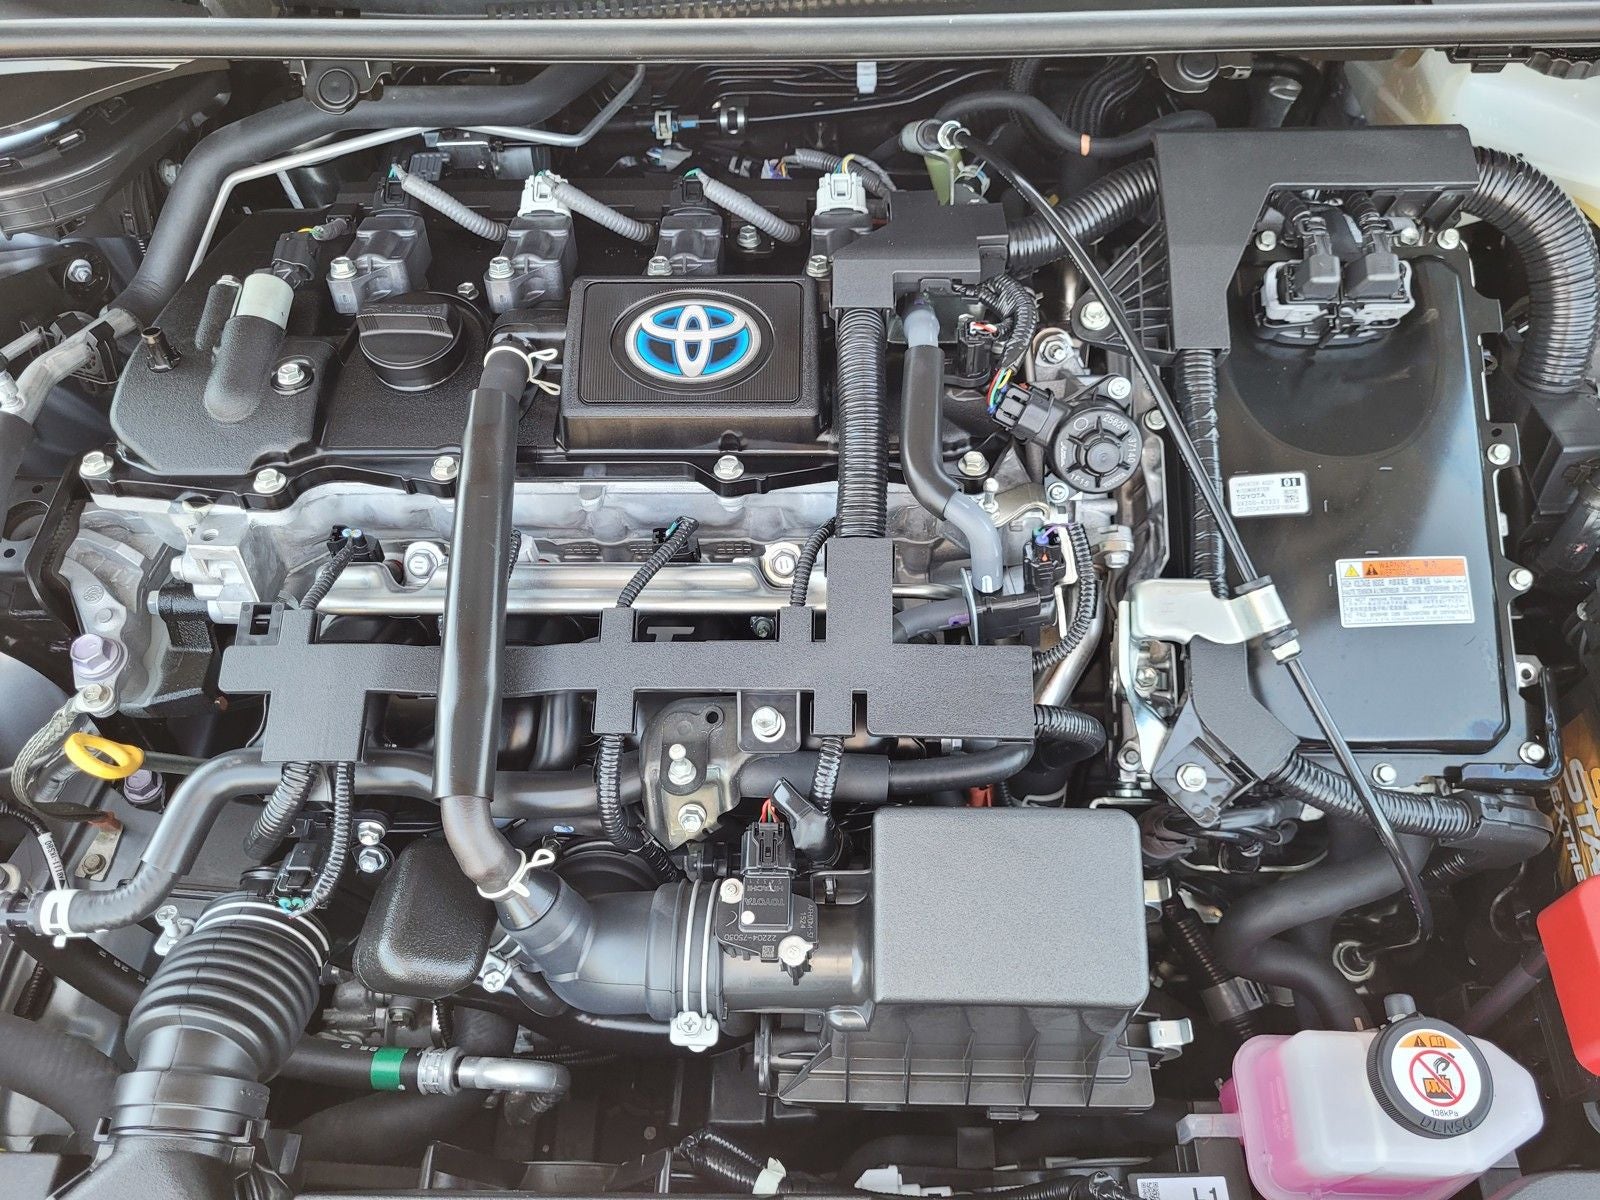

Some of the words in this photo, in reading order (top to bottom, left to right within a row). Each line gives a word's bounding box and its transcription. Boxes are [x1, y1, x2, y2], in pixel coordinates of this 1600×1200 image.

[1103, 413, 1128, 431] 25620
[1128, 438, 1137, 463] 37140
[745, 897, 785, 906] TOYOTA
[1431, 1109, 1459, 1117] 108kPa
[1420, 1116, 1473, 1134] DENSO
